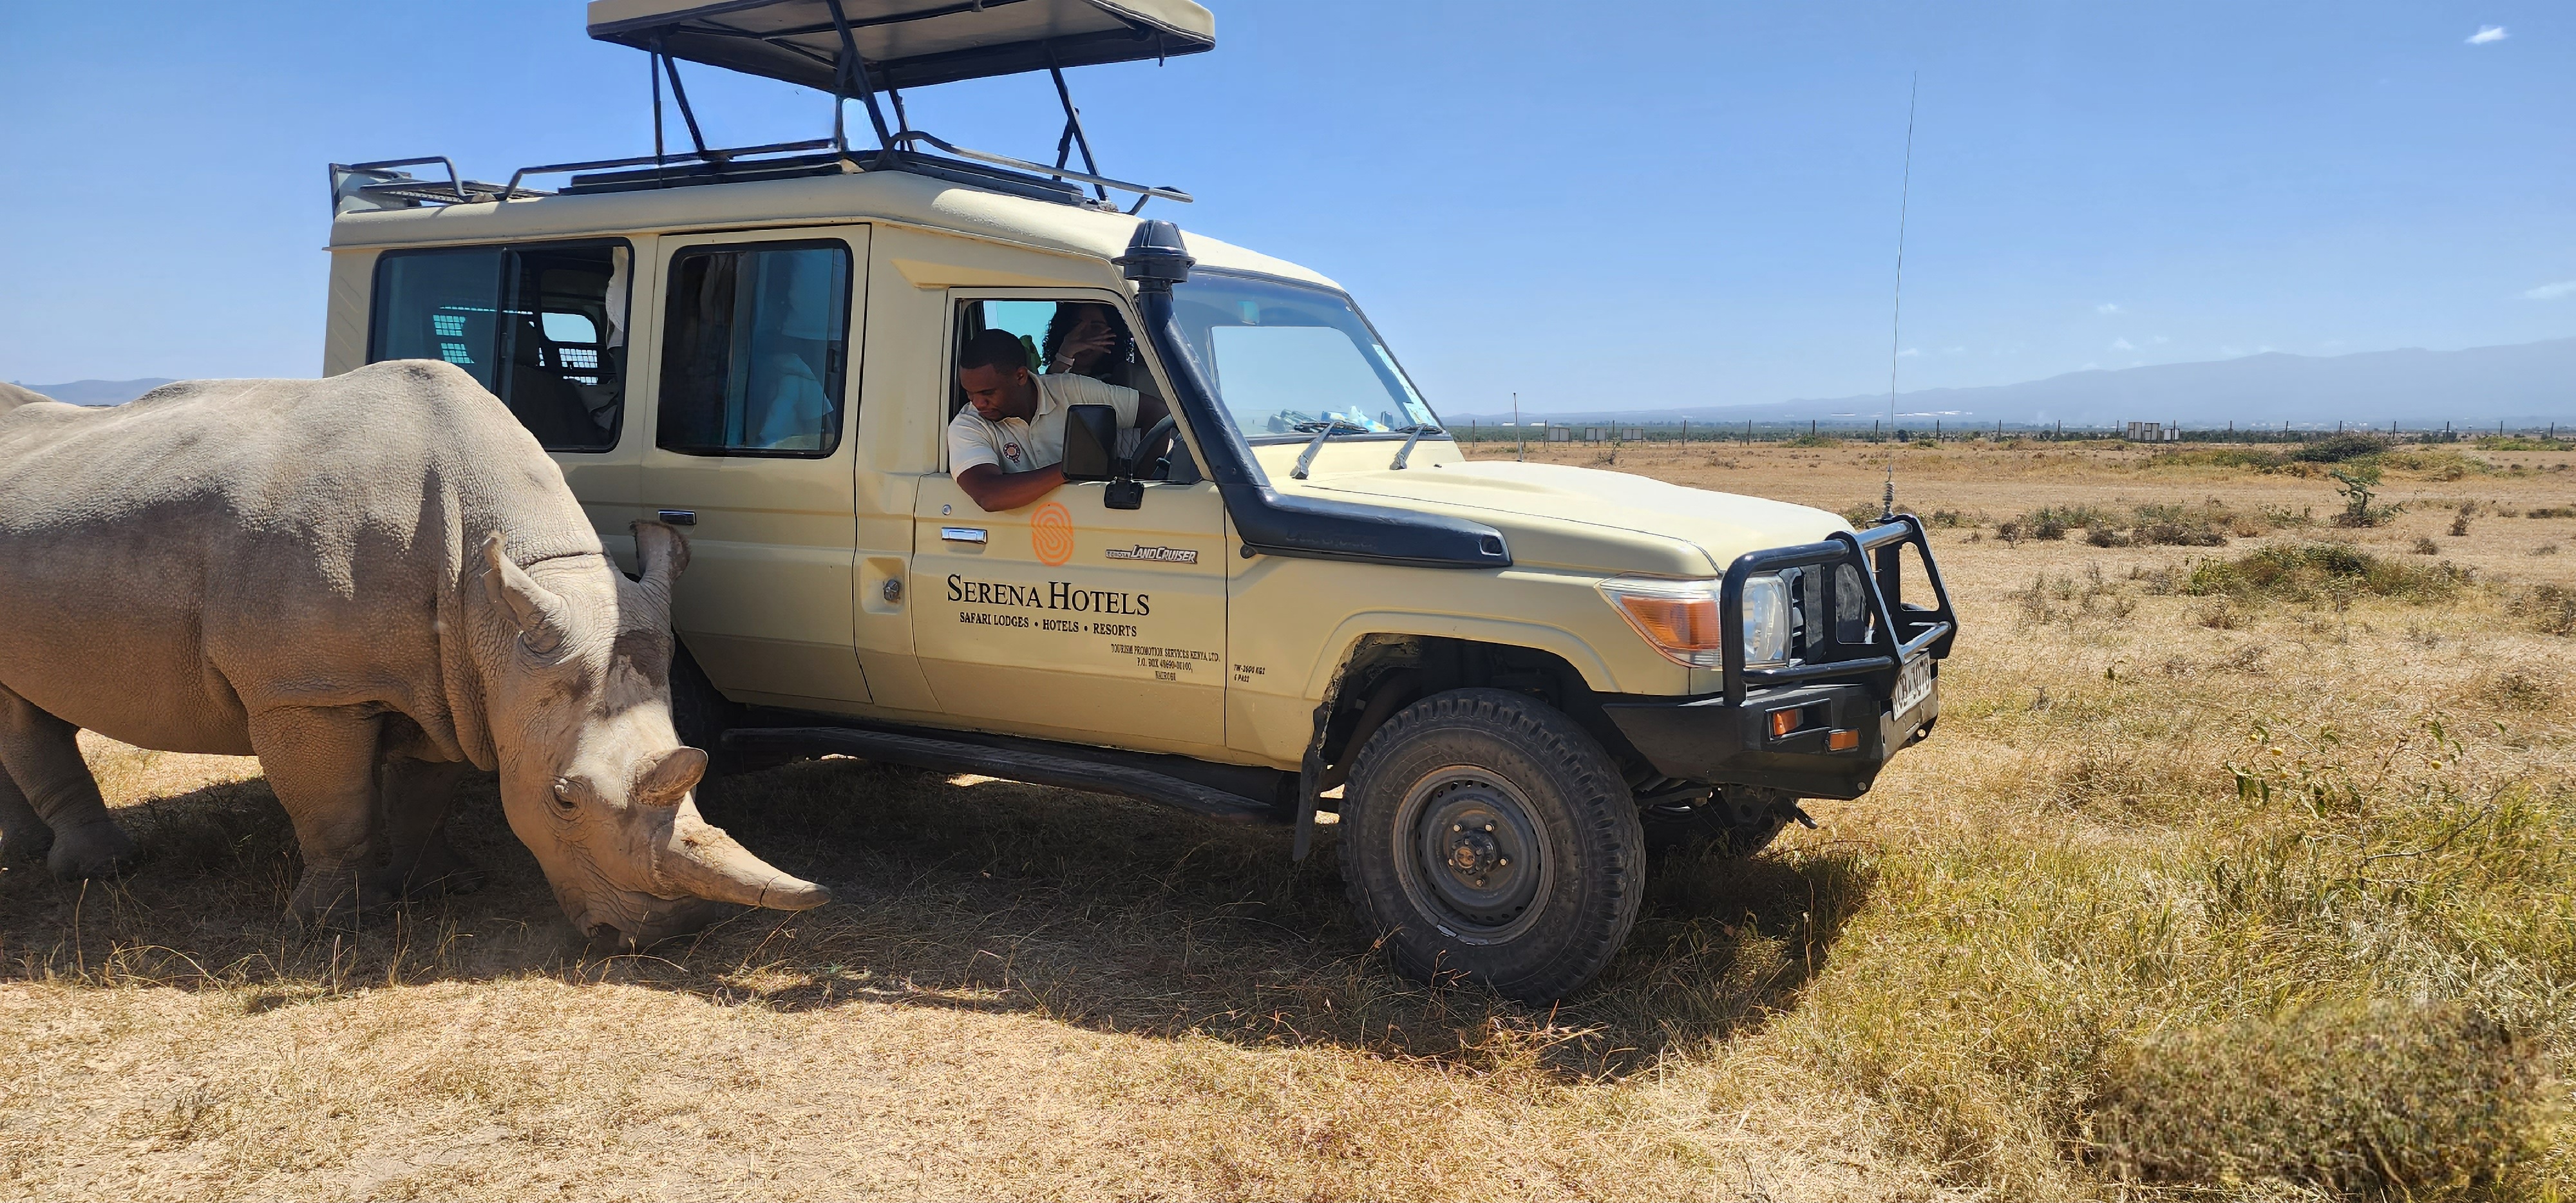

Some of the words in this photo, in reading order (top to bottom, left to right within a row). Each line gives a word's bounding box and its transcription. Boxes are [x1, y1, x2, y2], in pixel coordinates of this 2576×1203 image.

[947, 574, 1043, 609] SERENA
[1048, 582, 1150, 616] HOTELS
[960, 612, 992, 625] SAFARI
[994, 614, 1029, 628] LODGES
[1043, 619, 1079, 632] HOTELS
[1093, 623, 1137, 637] RESORTS
